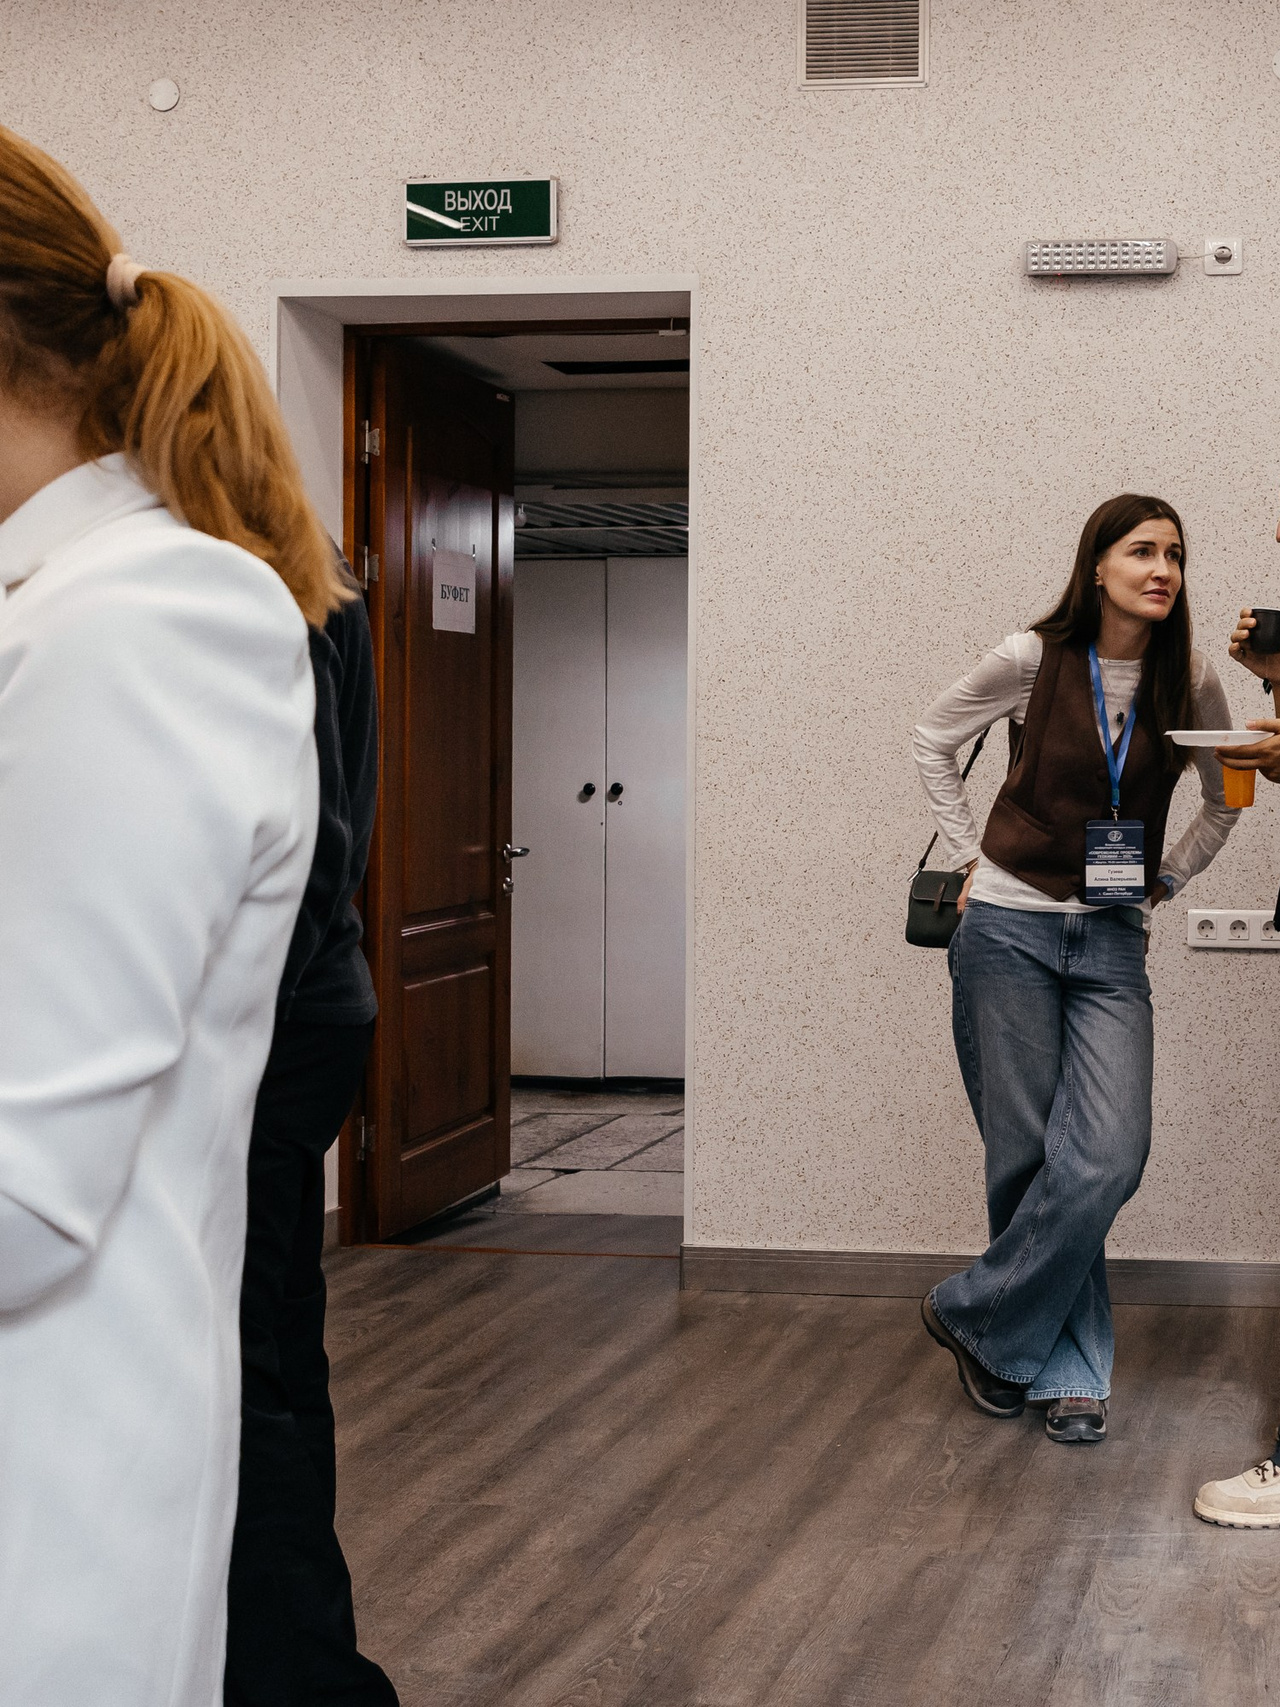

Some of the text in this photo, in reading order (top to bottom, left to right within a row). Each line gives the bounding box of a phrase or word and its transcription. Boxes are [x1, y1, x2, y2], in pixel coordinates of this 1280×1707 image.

[444, 189, 513, 214] ВЫХОД
[460, 216, 501, 232] EXIT
[440, 583, 470, 603] БУФЕТ
